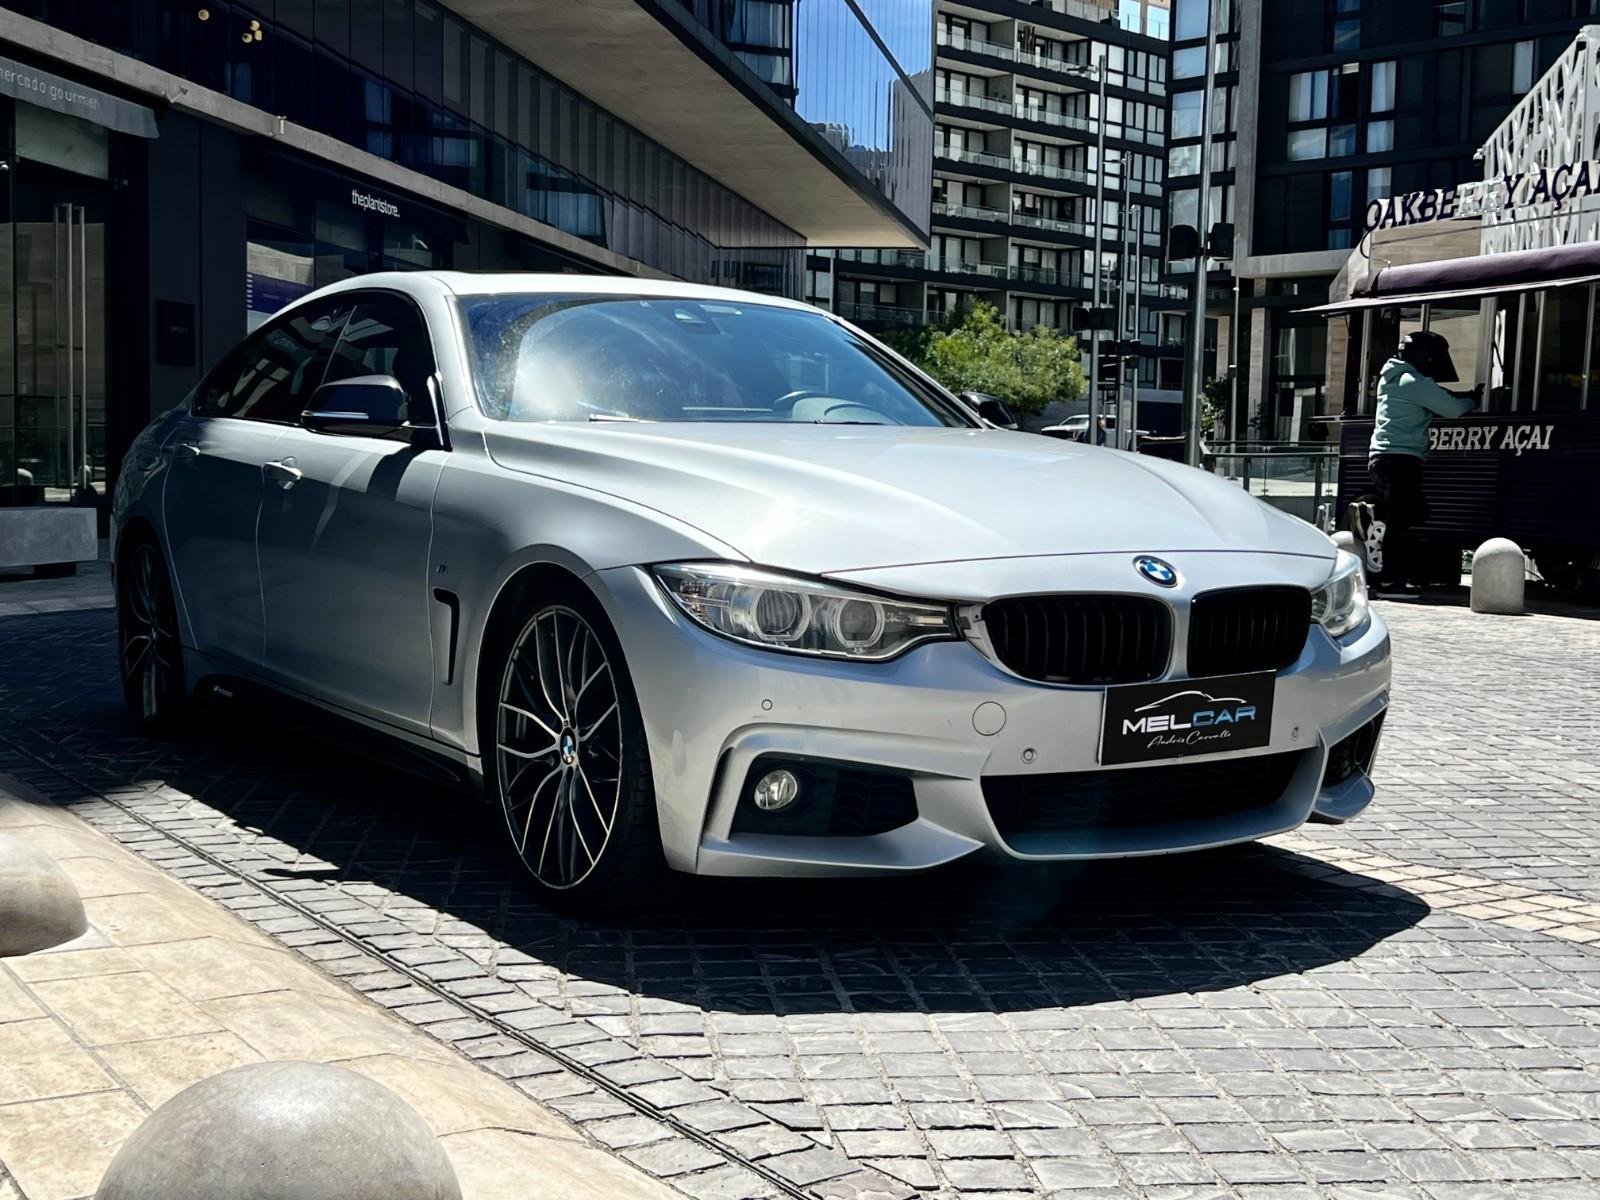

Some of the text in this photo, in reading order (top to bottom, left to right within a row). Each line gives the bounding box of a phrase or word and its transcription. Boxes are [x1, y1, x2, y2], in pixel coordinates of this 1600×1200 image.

[1365, 175, 1524, 231] OAKBERRY
[1499, 425, 1554, 456] AÇAI
[1122, 706, 1256, 735] MELCAR
